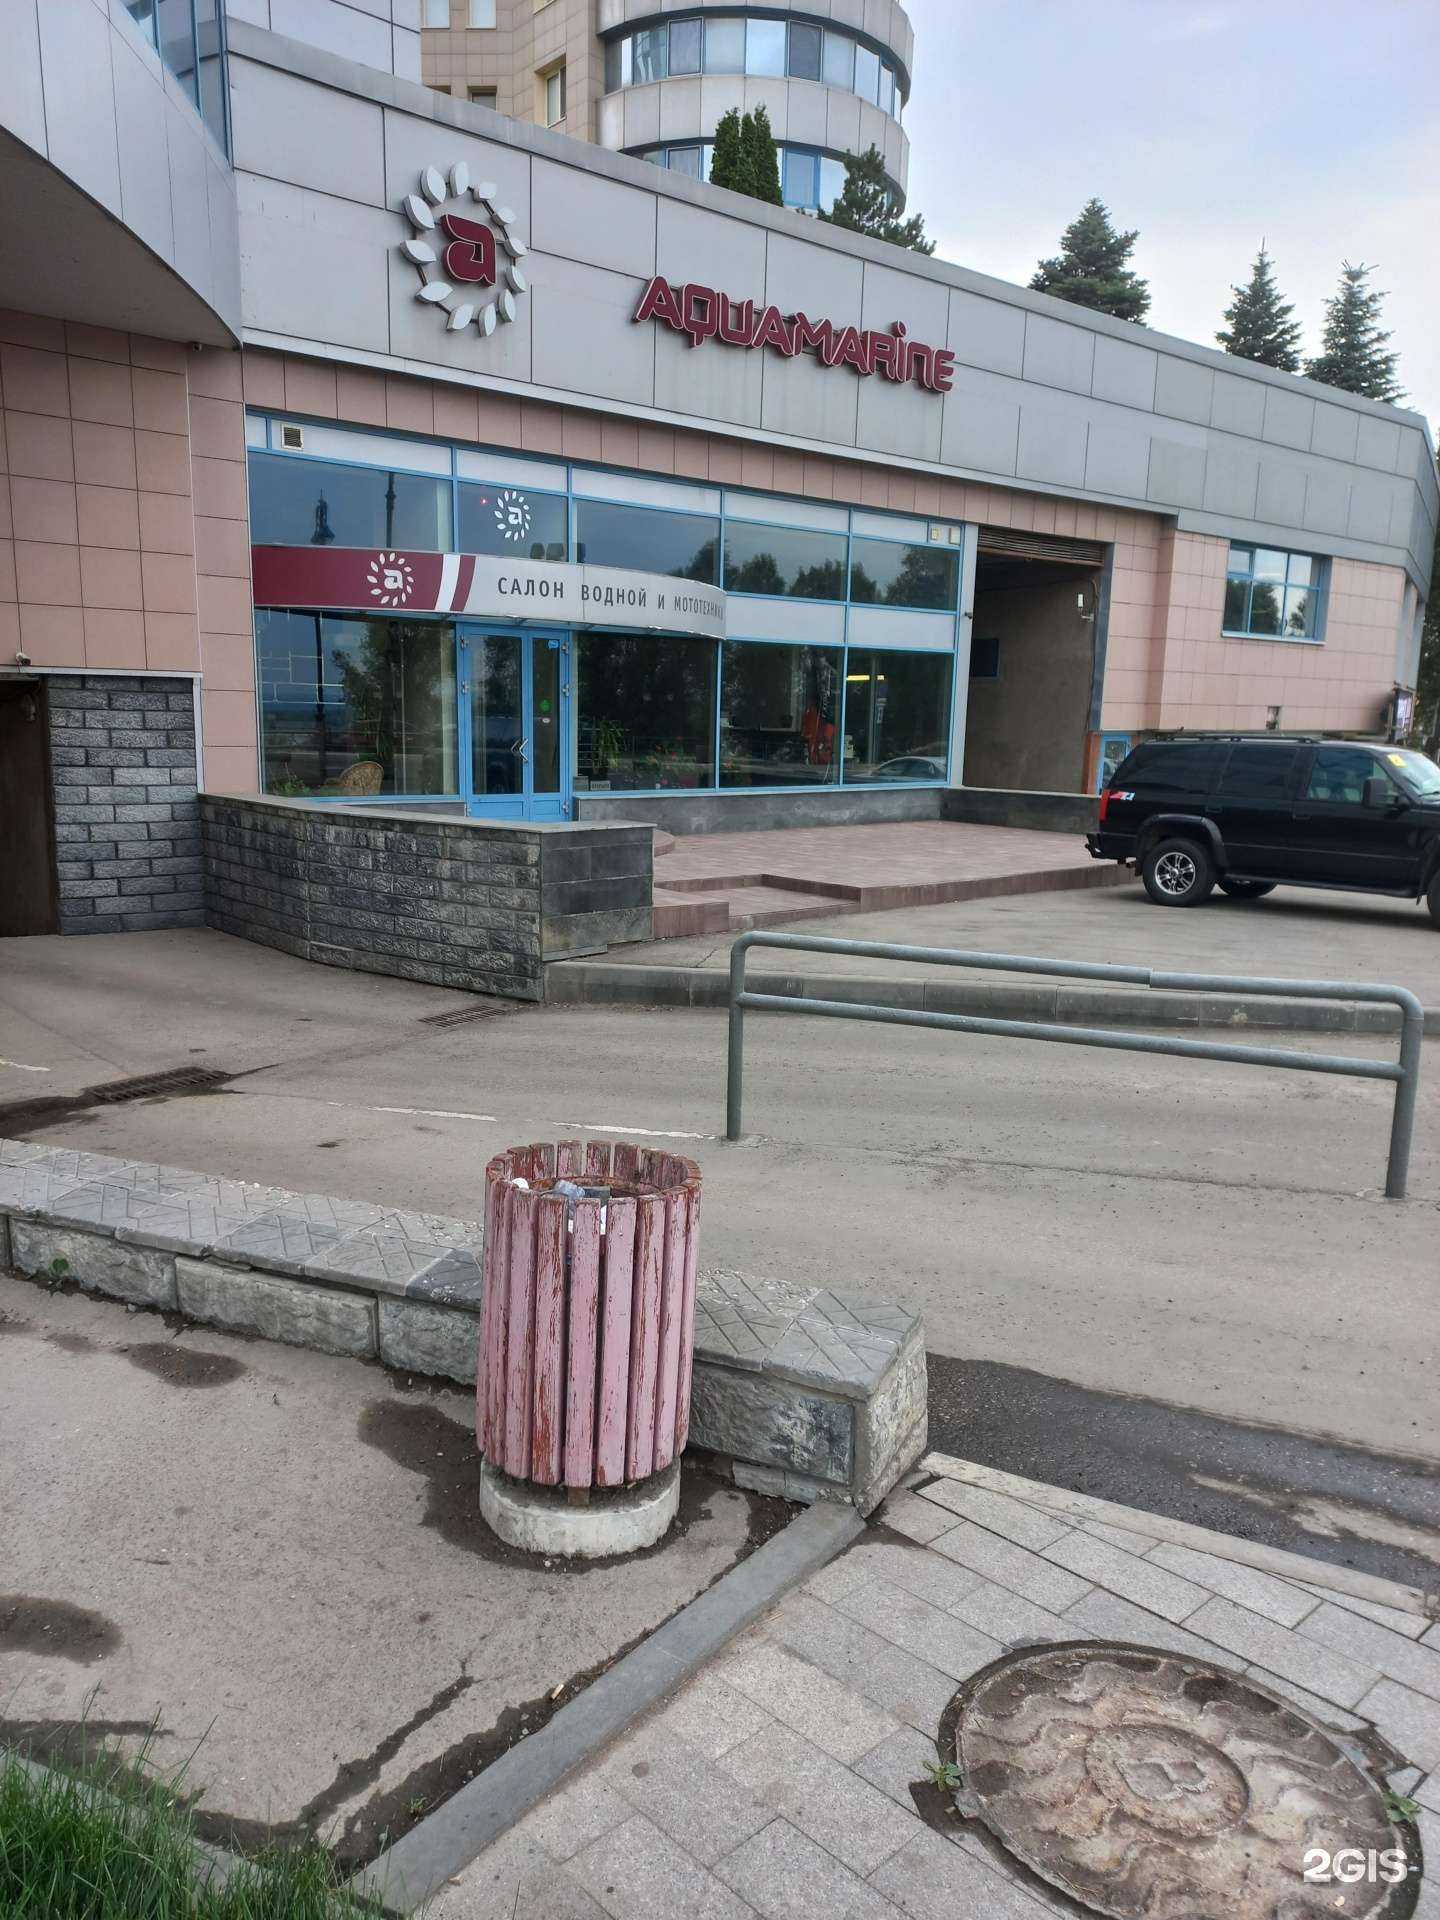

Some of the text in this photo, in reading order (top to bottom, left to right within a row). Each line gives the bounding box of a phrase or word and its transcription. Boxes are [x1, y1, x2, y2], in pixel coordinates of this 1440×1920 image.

[497, 576, 725, 621] САЛОН ВОДНОЙ И МОТОТЕХН
